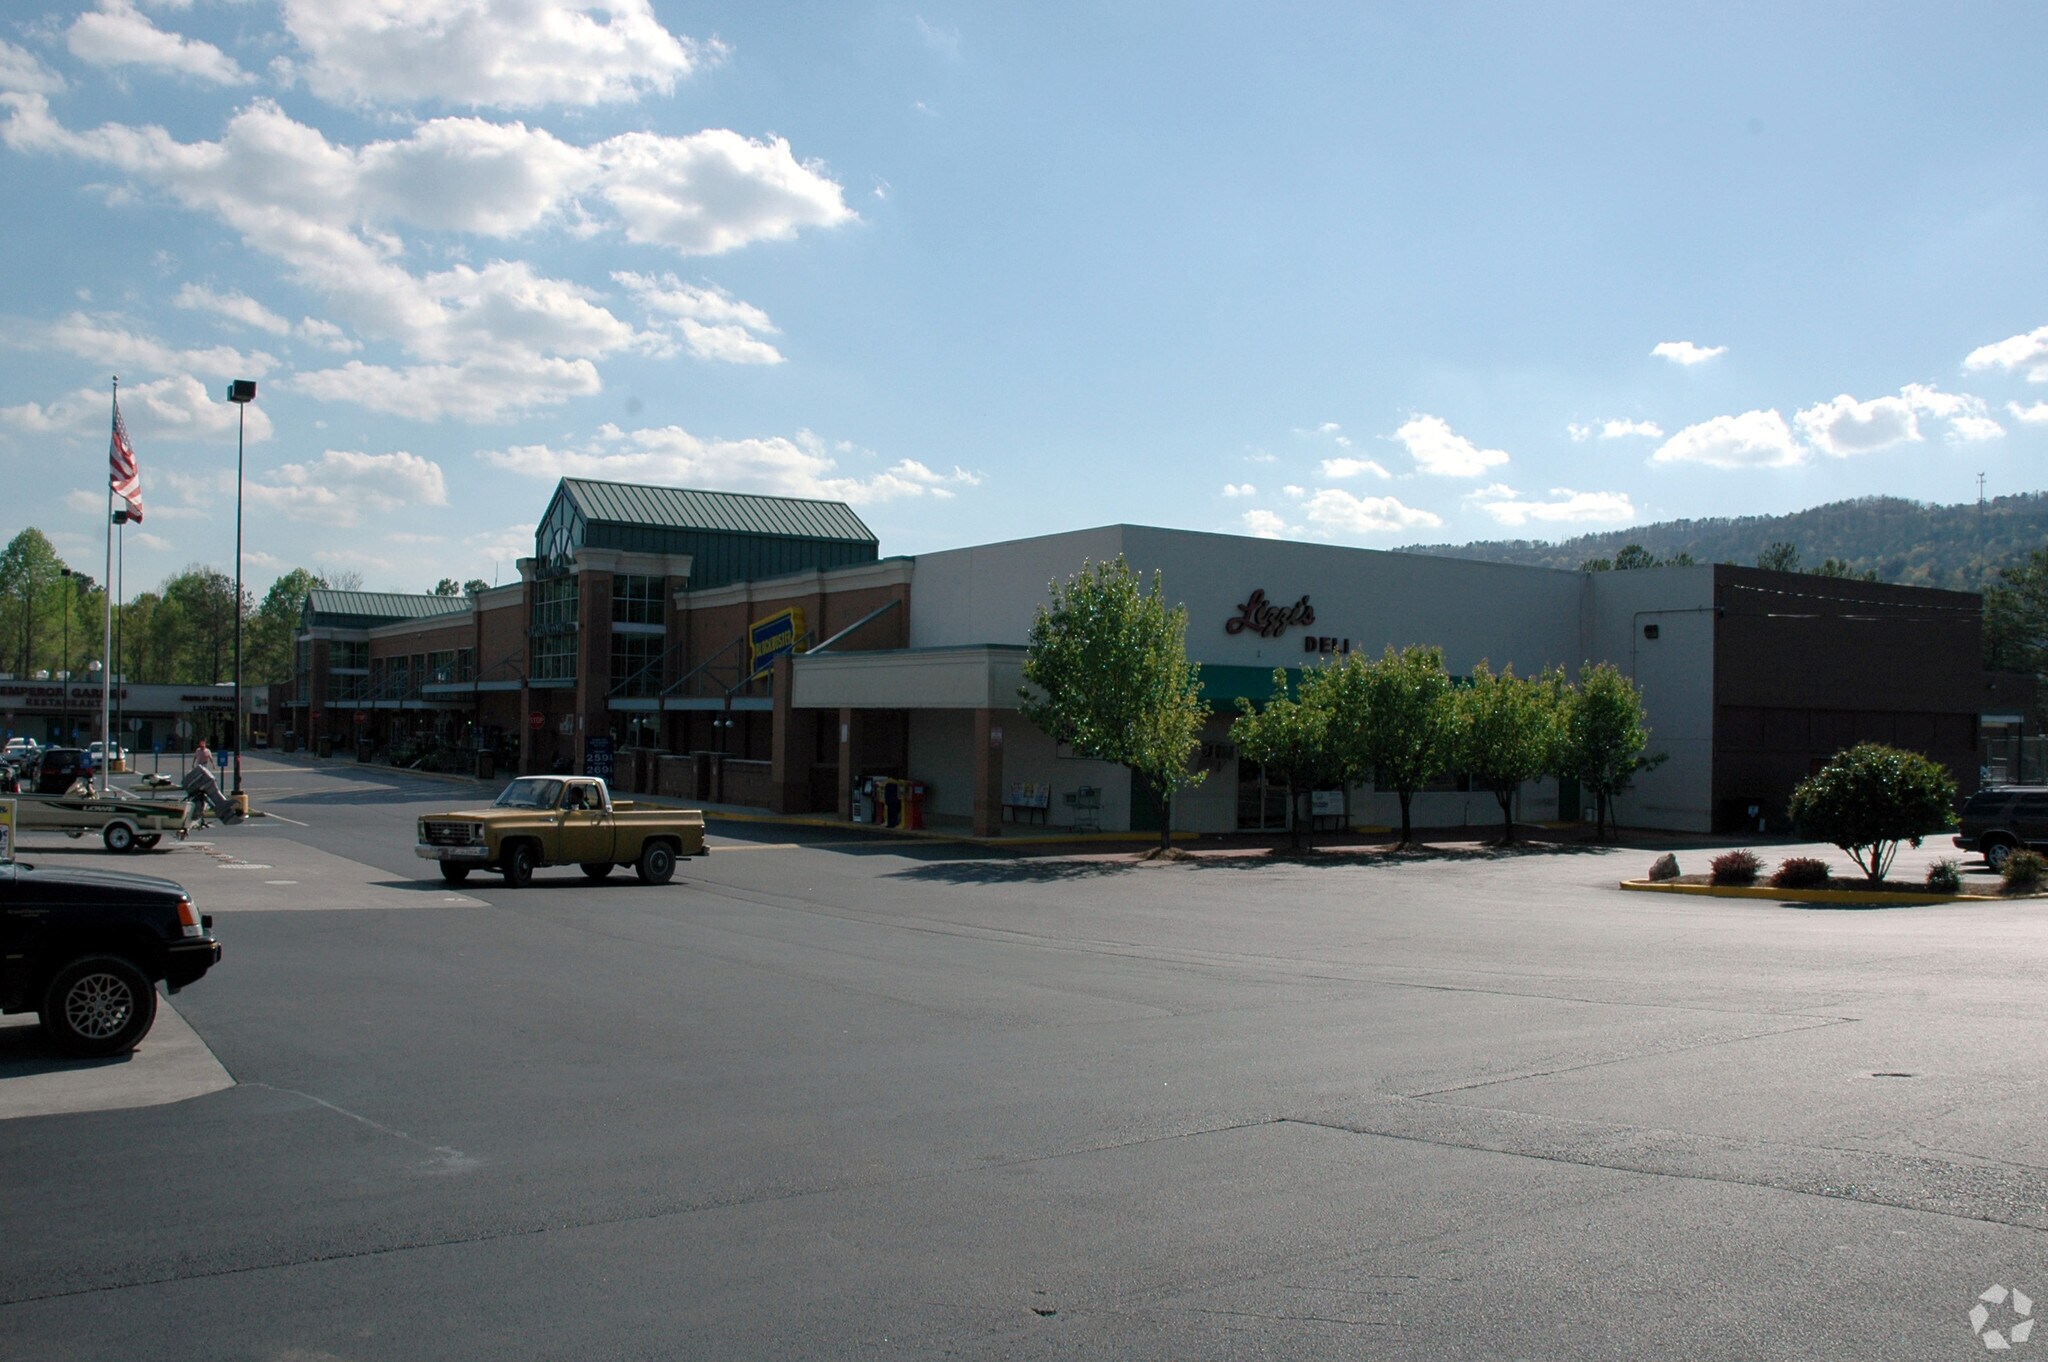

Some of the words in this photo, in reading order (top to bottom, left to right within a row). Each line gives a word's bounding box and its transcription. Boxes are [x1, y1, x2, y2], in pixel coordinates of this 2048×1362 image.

[1304, 636, 1350, 654] DELI
[0, 686, 64, 697] EMPEROR
[25, 698, 103, 707] RESTAURANT
[529, 716, 545, 725] STOP
[82, 804, 116, 813] LOWE
